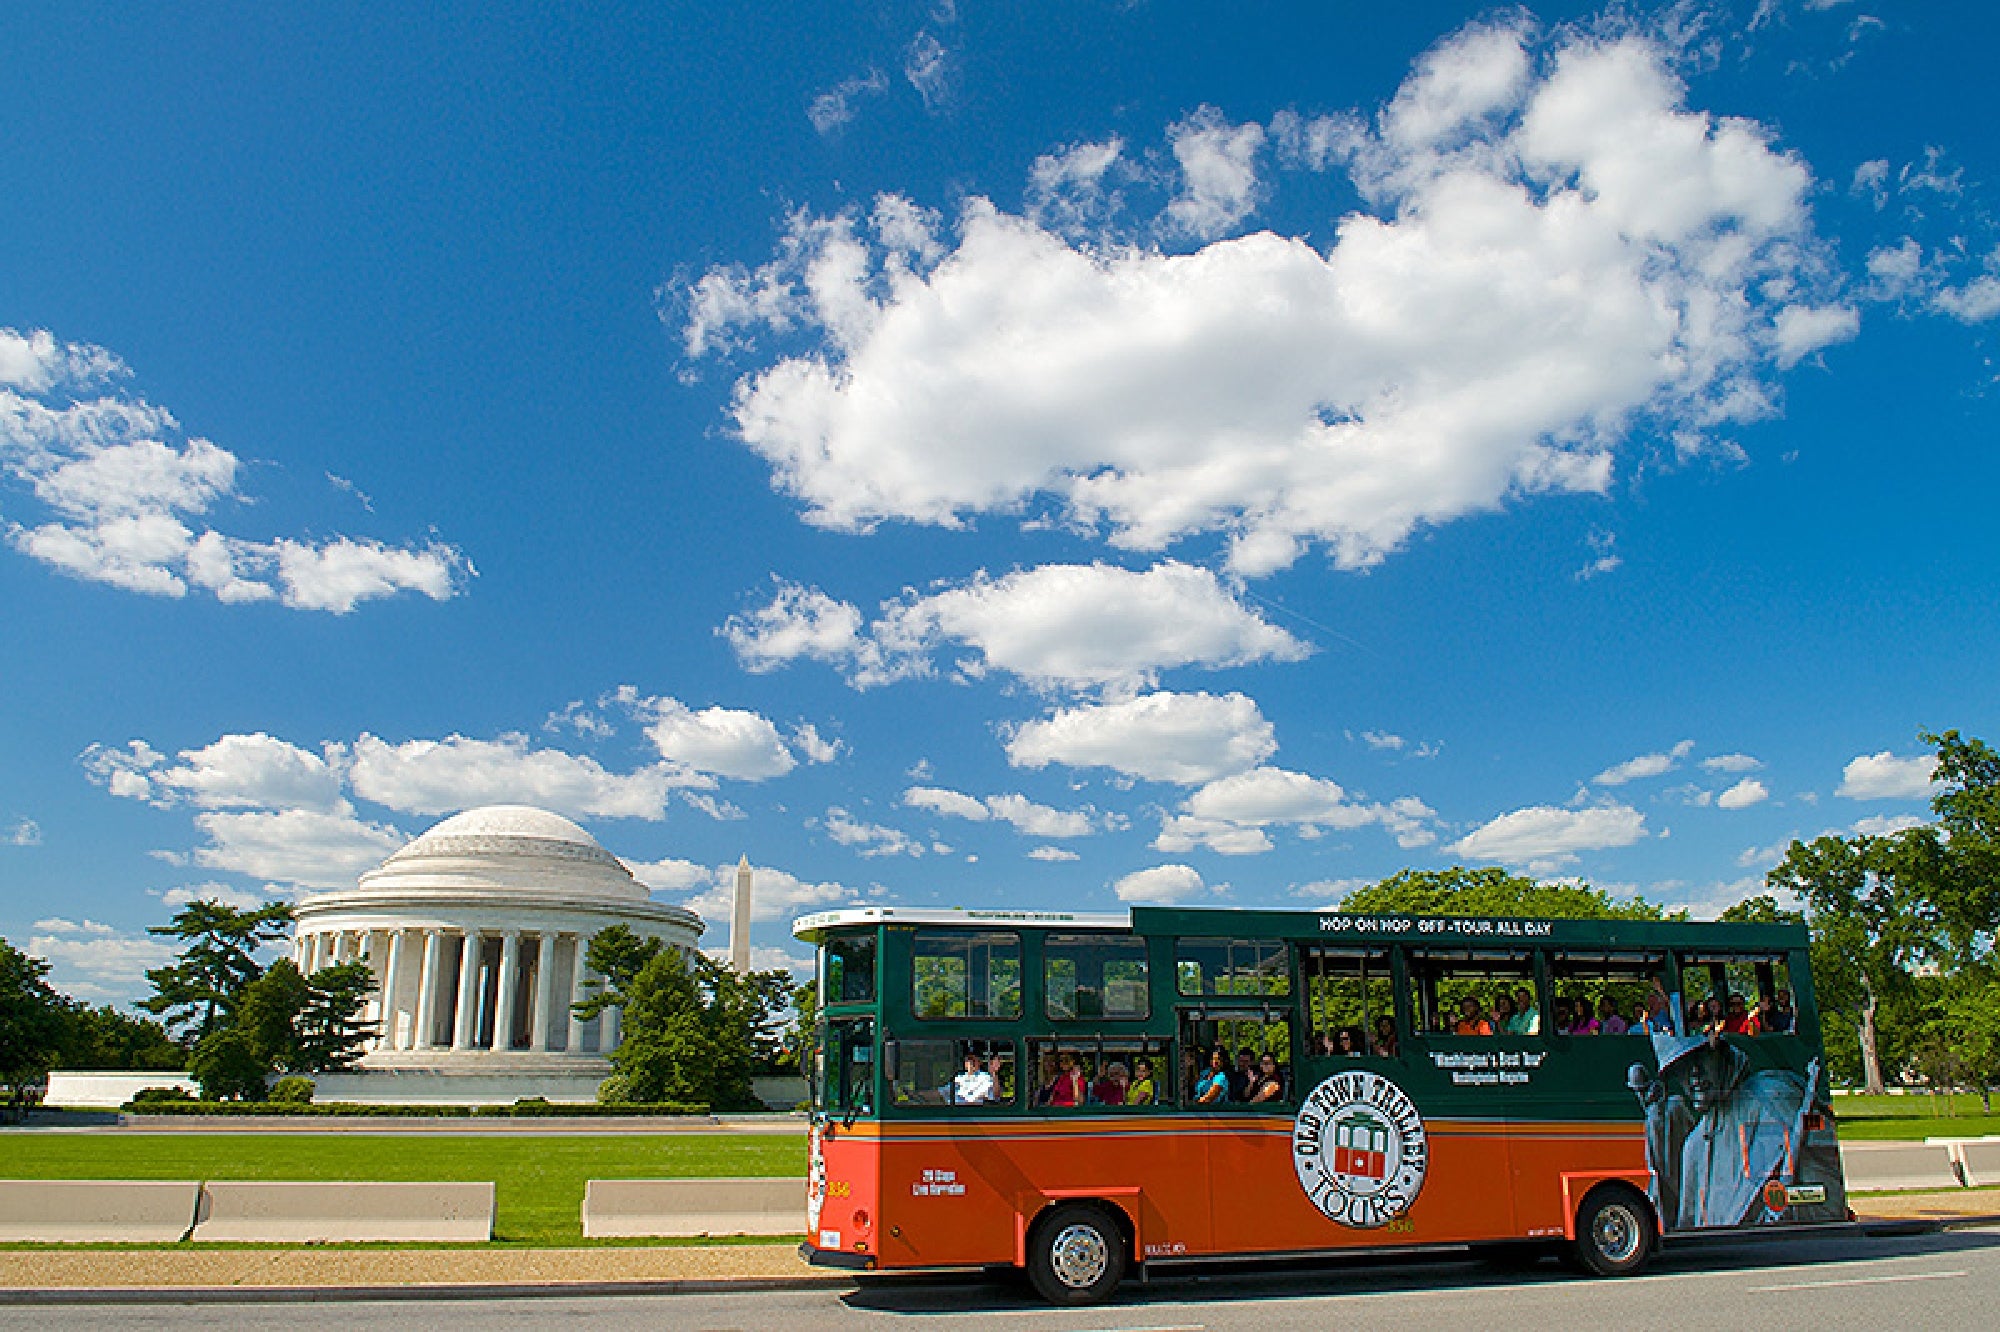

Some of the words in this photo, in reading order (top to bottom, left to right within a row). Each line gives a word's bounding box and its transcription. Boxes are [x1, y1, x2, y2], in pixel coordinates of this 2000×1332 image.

[1319, 917, 1351, 932] HOP
[1354, 917, 1379, 933] ON
[1380, 917, 1412, 933] HOP
[1417, 919, 1446, 935] OFF
[1496, 920, 1523, 936] ALL
[1524, 921, 1552, 936] DAY
[1297, 1112, 1320, 1156] OLD
[1310, 1074, 1365, 1116] TOWN
[1370, 1077, 1425, 1173] TROLLEY
[1309, 1169, 1408, 1226] TOURS
